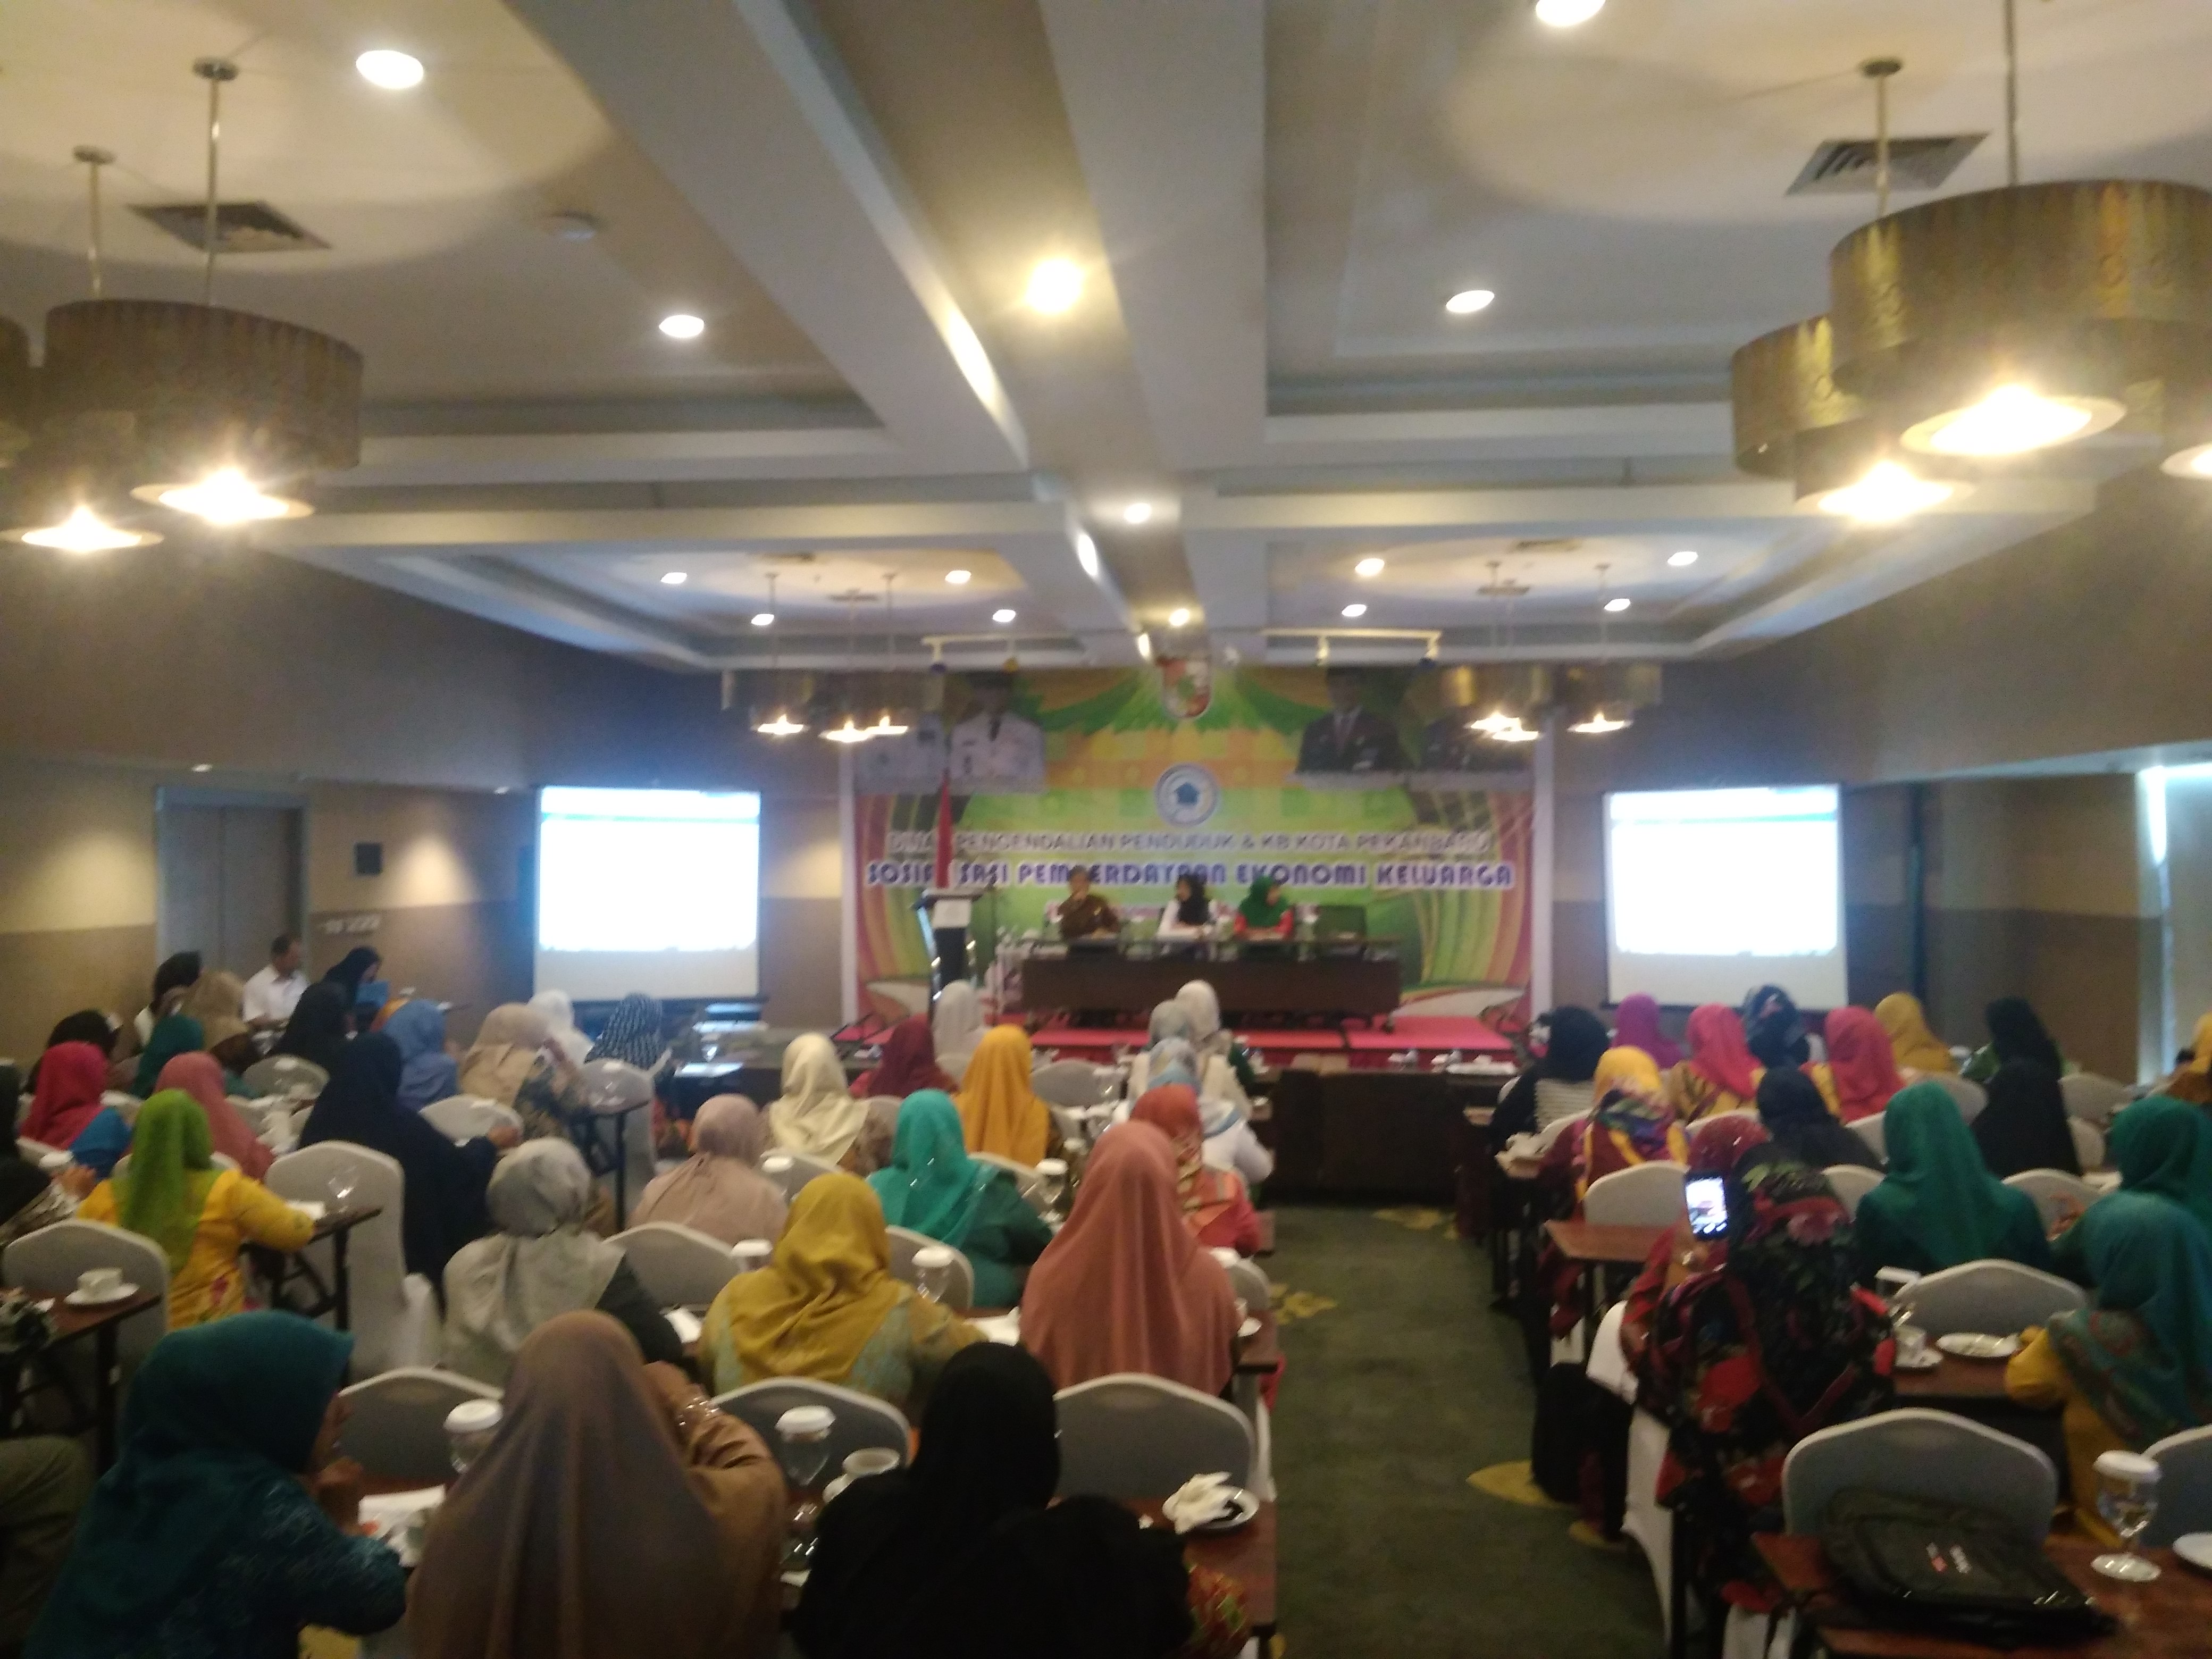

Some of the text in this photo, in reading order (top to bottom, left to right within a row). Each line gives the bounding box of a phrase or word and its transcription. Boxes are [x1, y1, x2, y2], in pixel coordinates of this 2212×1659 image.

[1295, 833, 1350, 850] KOTA
[867, 862, 1512, 886] SOSIASASI PEMERDAYAAN EKONOMI KELUARGA
